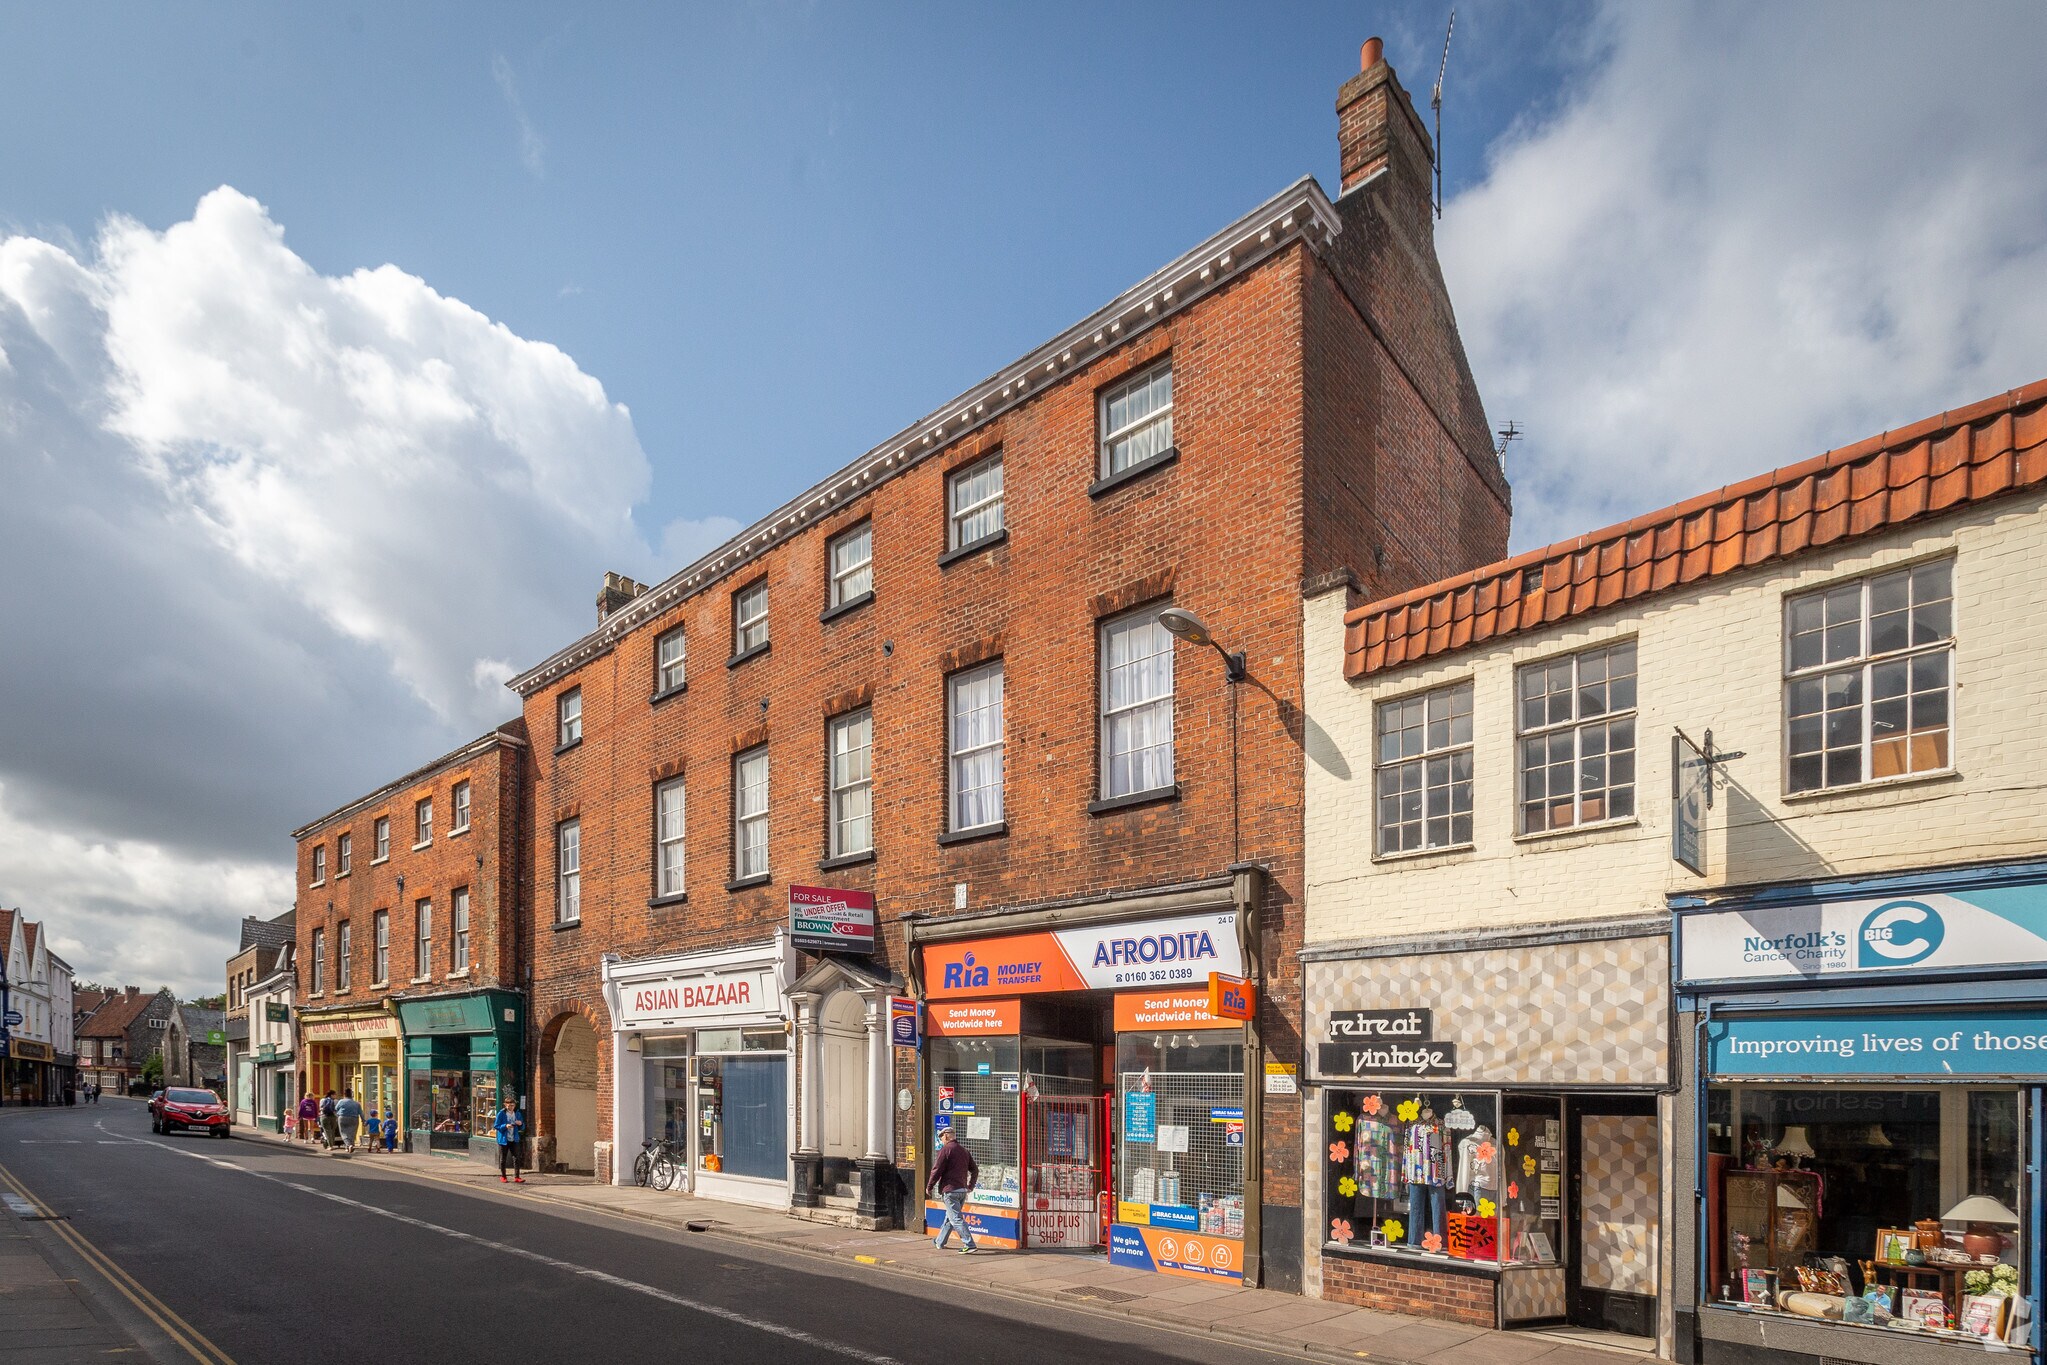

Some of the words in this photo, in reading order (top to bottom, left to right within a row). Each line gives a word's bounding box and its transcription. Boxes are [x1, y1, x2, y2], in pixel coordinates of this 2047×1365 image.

[793, 893, 810, 902] FOR
[811, 894, 831, 904] SALE
[804, 906, 825, 917] UNDER
[826, 903, 846, 913] OFFER
[1744, 931, 1846, 952] Norfolk's
[1864, 928, 1893, 942] BIG
[1092, 930, 1218, 968] AFRODITA
[1743, 952, 1790, 963] Cancer
[1796, 948, 1846, 960] Charity
[943, 952, 989, 989] Ria
[997, 962, 1042, 975] MONEY
[1125, 971, 1147, 982] 0160
[1150, 970, 1166, 980] 362
[1169, 968, 1193, 979] 0389
[997, 975, 1042, 985] TRANSFER
[635, 988, 678, 1011] ASIAN
[683, 981, 750, 1008] BAZAAR
[1223, 987, 1246, 1010] Ria
[1144, 998, 1170, 1010] Send
[1172, 998, 1210, 1009] Money
[949, 1008, 968, 1018] Send
[969, 1008, 996, 1017] Money
[1135, 1011, 1192, 1023] Worldwide
[356, 1018, 389, 1031] COMPANY
[942, 1019, 983, 1029] Worldwide
[984, 1019, 1003, 1027] here
[1330, 1011, 1422, 1036] retreat
[1729, 1034, 1855, 1058] Improving
[1862, 1034, 1923, 1051] lives
[1932, 1031, 1963, 1051] of
[1972, 1031, 2047, 1051] those
[1351, 1044, 1453, 1074] vintage
[973, 1191, 1013, 1204] Lycamobile
[1058, 1215, 1080, 1228] PLUS
[1156, 1211, 1171, 1219] BRAC
[1172, 1212, 1195, 1221] SAAJAN
[1040, 1231, 1064, 1243] SHOP
[1124, 1237, 1140, 1246] give
[1112, 1246, 1125, 1254] you
[1126, 1248, 1144, 1256] more
[1183, 1264, 1206, 1272] Economical
[1213, 1268, 1228, 1276] Secure
